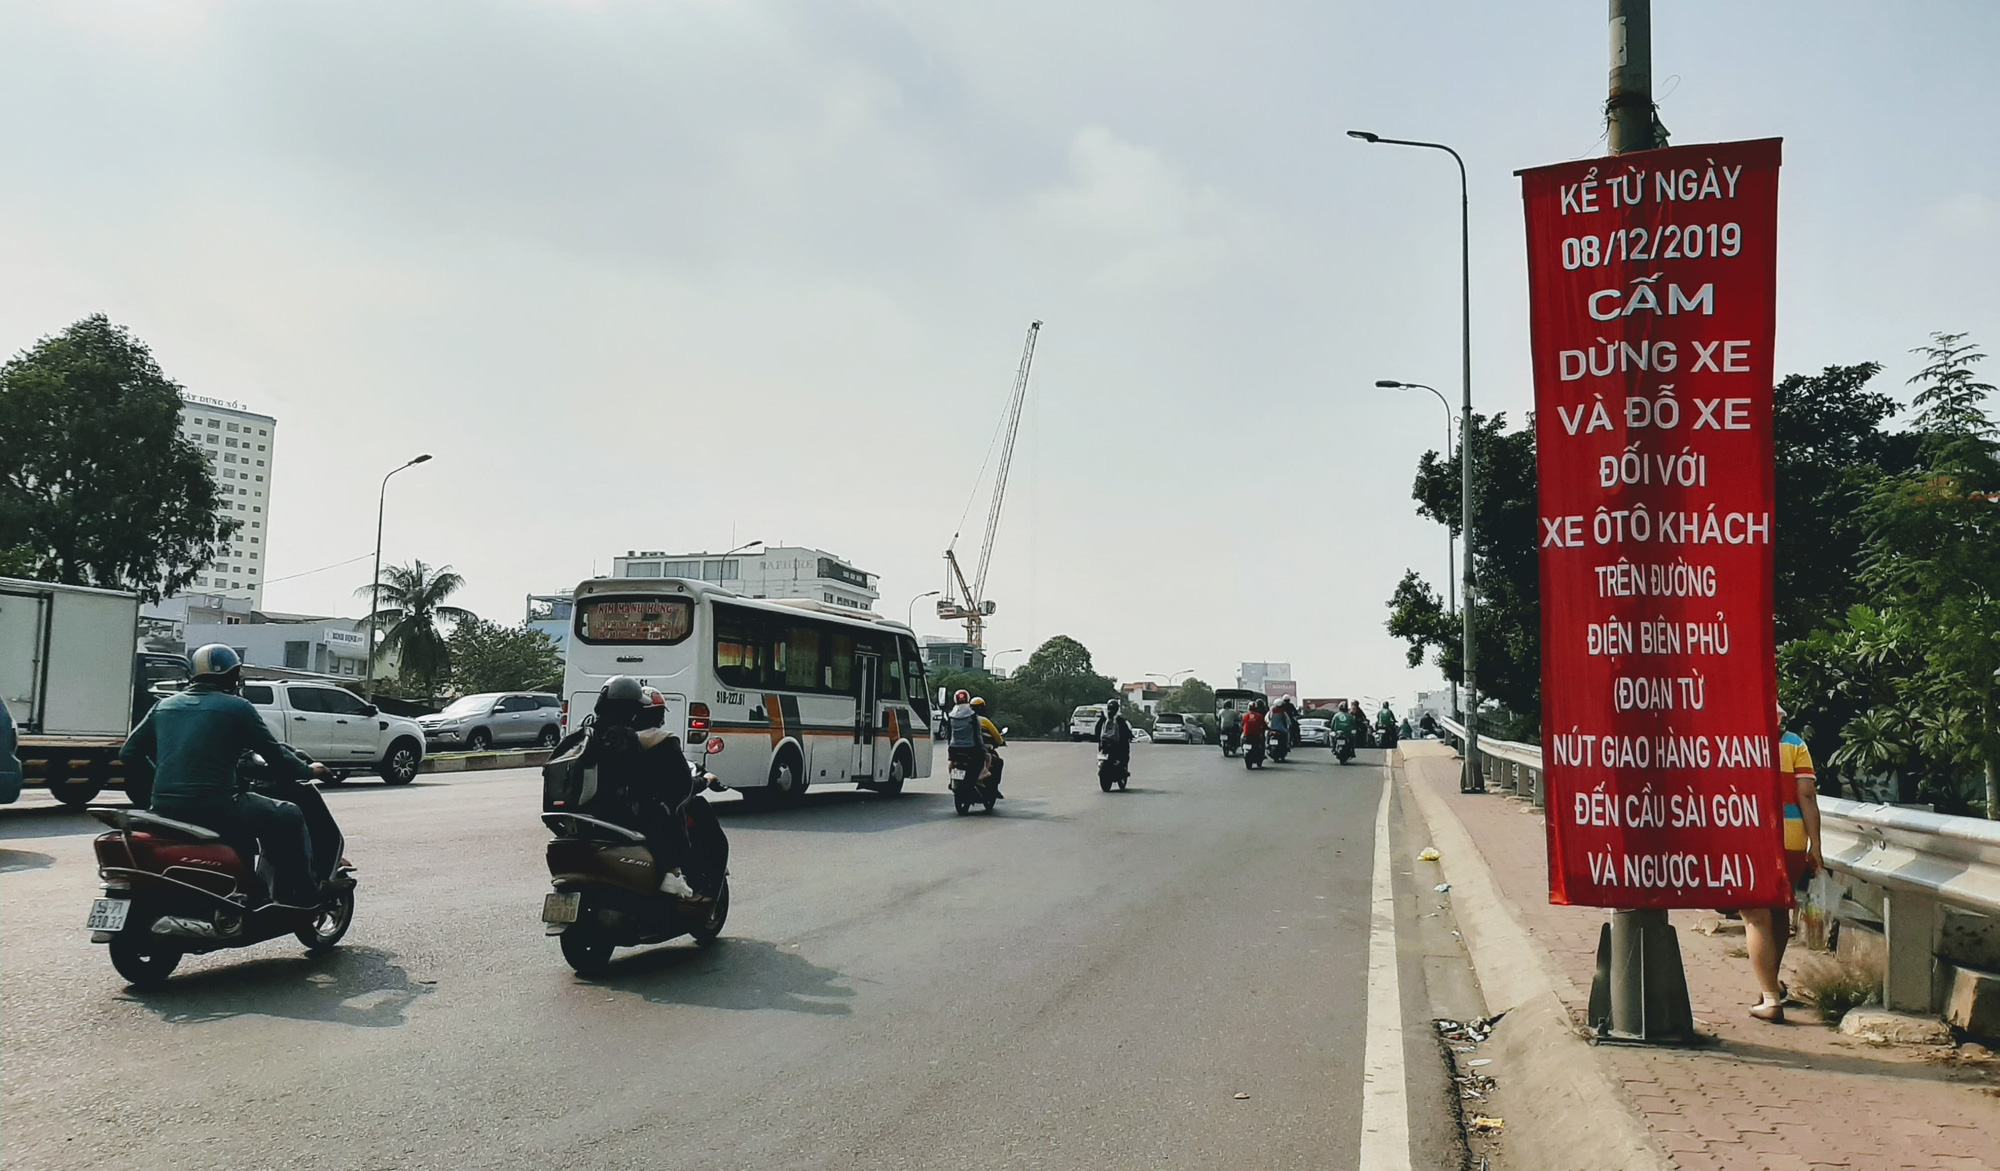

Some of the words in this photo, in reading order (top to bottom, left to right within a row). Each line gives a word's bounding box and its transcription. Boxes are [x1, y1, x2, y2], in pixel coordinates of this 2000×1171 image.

[1561, 167, 1600, 216] KỂ
[1606, 165, 1647, 209] TỪ
[1656, 158, 1742, 203] NGÀY
[1561, 222, 1742, 271] 08/12/2019
[1588, 272, 1715, 321] CẤM
[1559, 337, 1678, 382] DỪNG
[1690, 339, 1752, 374] XE
[1557, 393, 1614, 436] VÀ
[1623, 383, 1681, 430] ĐỖ
[1692, 397, 1752, 431] XE
[1598, 440, 1650, 488] ĐỐI
[1656, 445, 1707, 487] VỚI
[1541, 515, 1585, 549] XE
[1592, 502, 1652, 545] ÔTÔ
[1658, 503, 1770, 545] KHÁCH
[1593, 556, 1647, 598] TRÊN
[1650, 555, 1718, 598] ĐƯỜNG
[1586, 614, 1633, 664] ĐIỆN
[1640, 613, 1681, 655] BIÊN
[1686, 610, 1729, 656] PHỦ
[1613, 676, 1674, 718] (ĐOẠN
[1676, 668, 1705, 711] TỪ
[1552, 725, 1597, 769] NÚT
[1601, 735, 1650, 770] GIAO
[1654, 727, 1711, 770] HÀNG
[1715, 734, 1772, 769] XANH
[1573, 780, 1620, 828] ĐẾN
[1624, 782, 1666, 828] CẦU
[1670, 786, 1707, 828] SÀI
[1711, 786, 1761, 828] GÒN
[1587, 844, 1618, 888] VÀ
[1623, 851, 1701, 896] NGƯỢC
